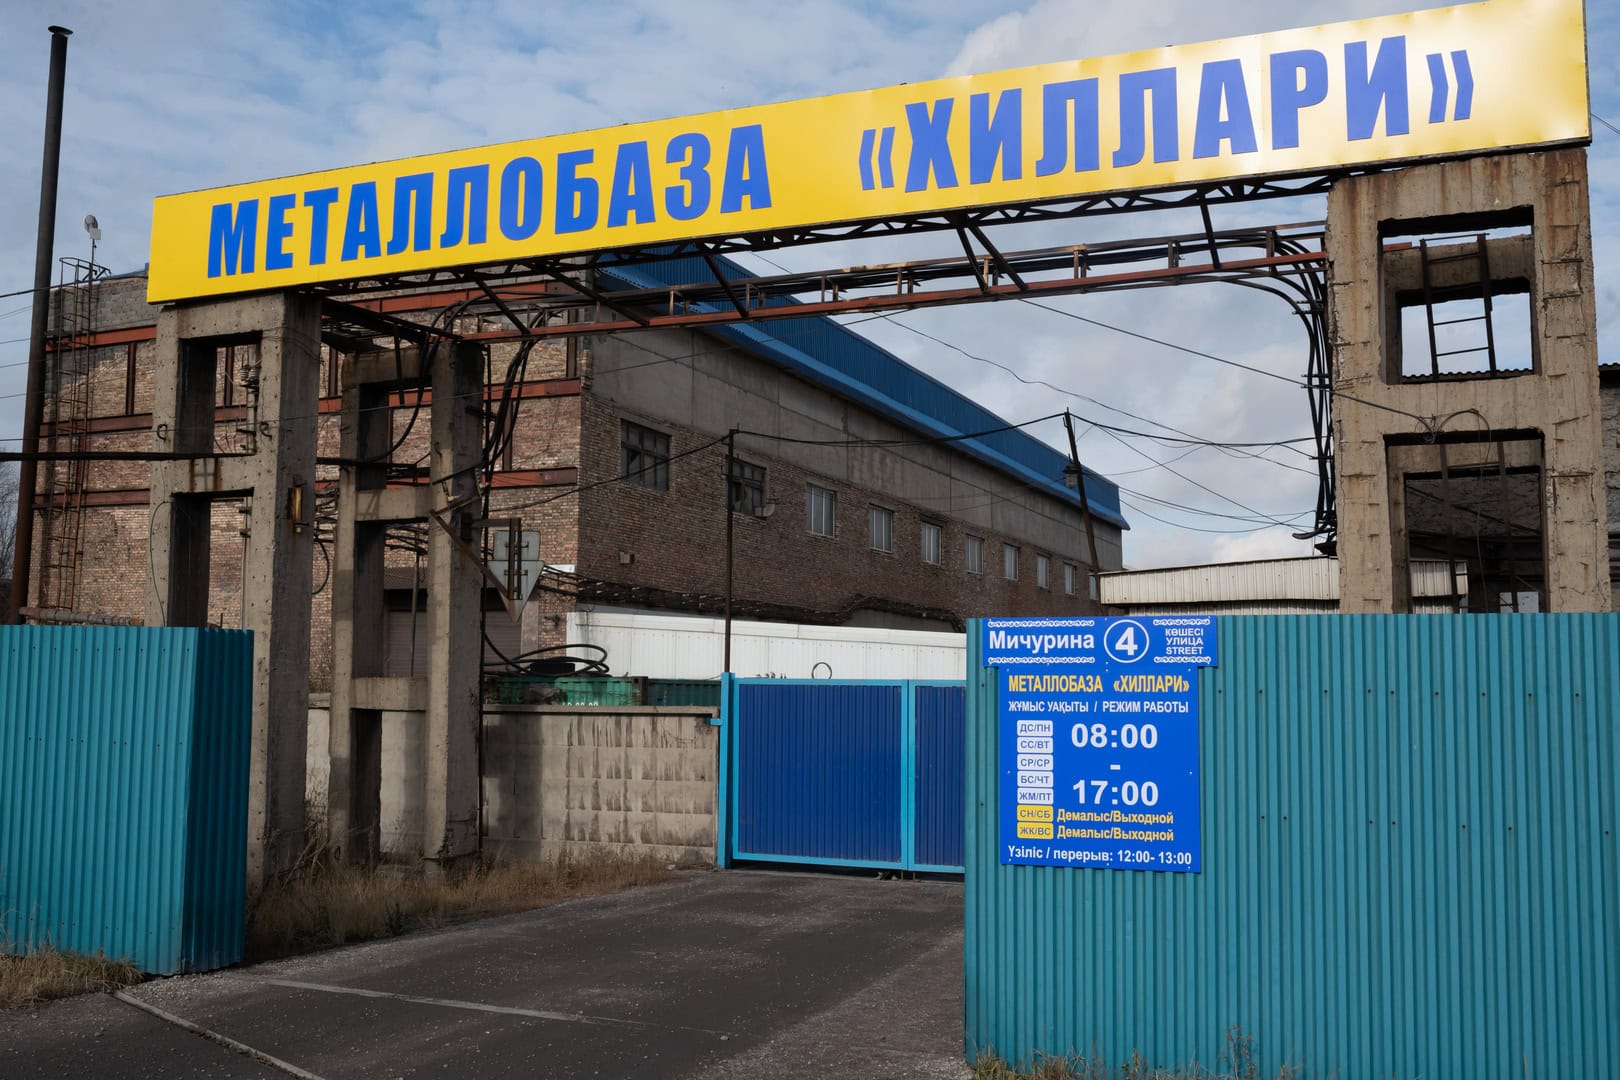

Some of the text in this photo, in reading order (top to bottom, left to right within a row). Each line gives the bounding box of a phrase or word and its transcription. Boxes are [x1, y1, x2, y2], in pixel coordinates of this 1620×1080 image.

[207, 35, 1474, 279] МЕТАЛЛОБАЗА «ХИЛЛАРИ»
[1165, 628, 1204, 636] КӨШЕСІ
[989, 627, 1138, 656] Мичурина 4
[1166, 637, 1204, 646] УЛИЦА
[1166, 647, 1204, 655] STREET
[1008, 675, 1190, 693] МЕТАЛЛОБАЗА «ХИЛЛАРИ»
[1008, 701, 1189, 714] ЖҰМЫС УАҚЫТЫ / РЕЖИМ РАБОТЫ
[1020, 723, 1051, 732] ДС/ПН
[1071, 723, 1158, 749] 08:00
[1020, 740, 1050, 749] СС/ВТ
[1020, 758, 1050, 767] СР/СР
[1020, 775, 1050, 784] БС/ЧТ
[1019, 792, 1052, 801] ЖМ/ПТ
[1072, 779, 1158, 806] 17:00
[1020, 808, 1174, 824] СН/СБ Демалыс/Выходной
[1020, 826, 1174, 841] ЖК/ВС Демалыс/Выходной
[1008, 845, 1043, 858] Үзіліс
[1046, 847, 1050, 858] /
[1053, 850, 1113, 863] перерыв:
[1158, 852, 1192, 865] 13:00
